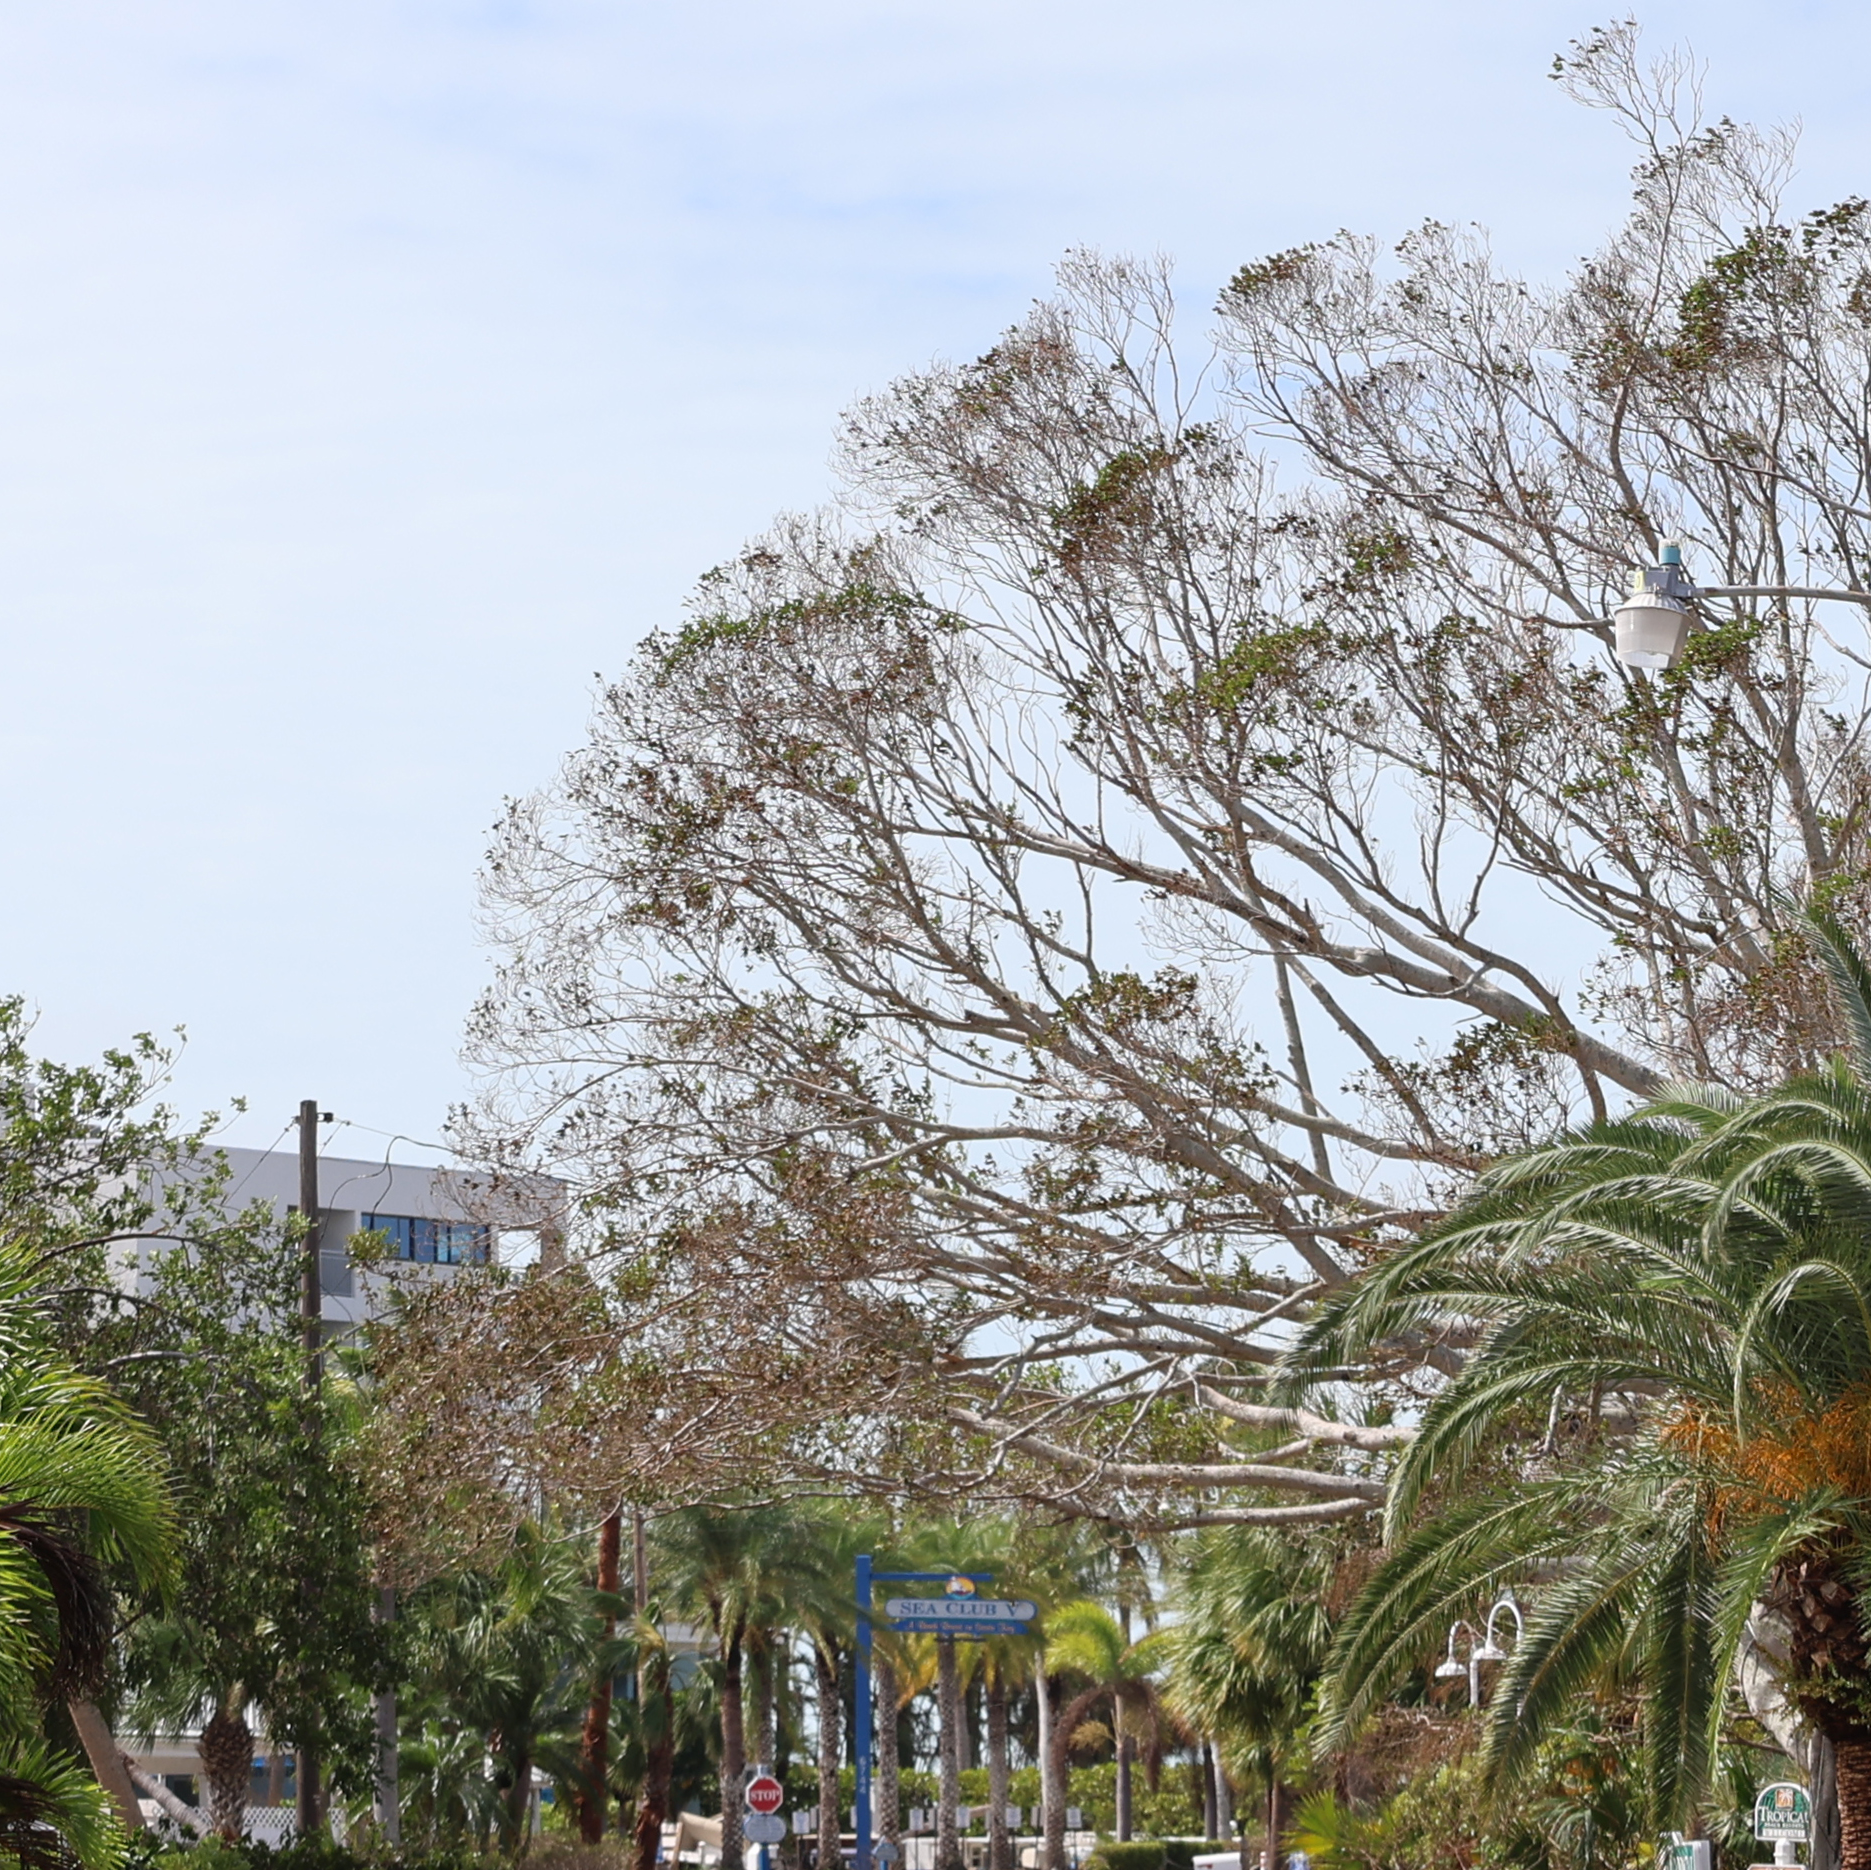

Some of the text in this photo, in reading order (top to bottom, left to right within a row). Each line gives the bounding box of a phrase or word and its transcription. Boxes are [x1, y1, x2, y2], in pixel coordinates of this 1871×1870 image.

[900, 1602, 1020, 1617] SEA CLUB V
[751, 1790, 780, 1801] STOP
[1758, 1806, 1809, 1823] TROPICAL
